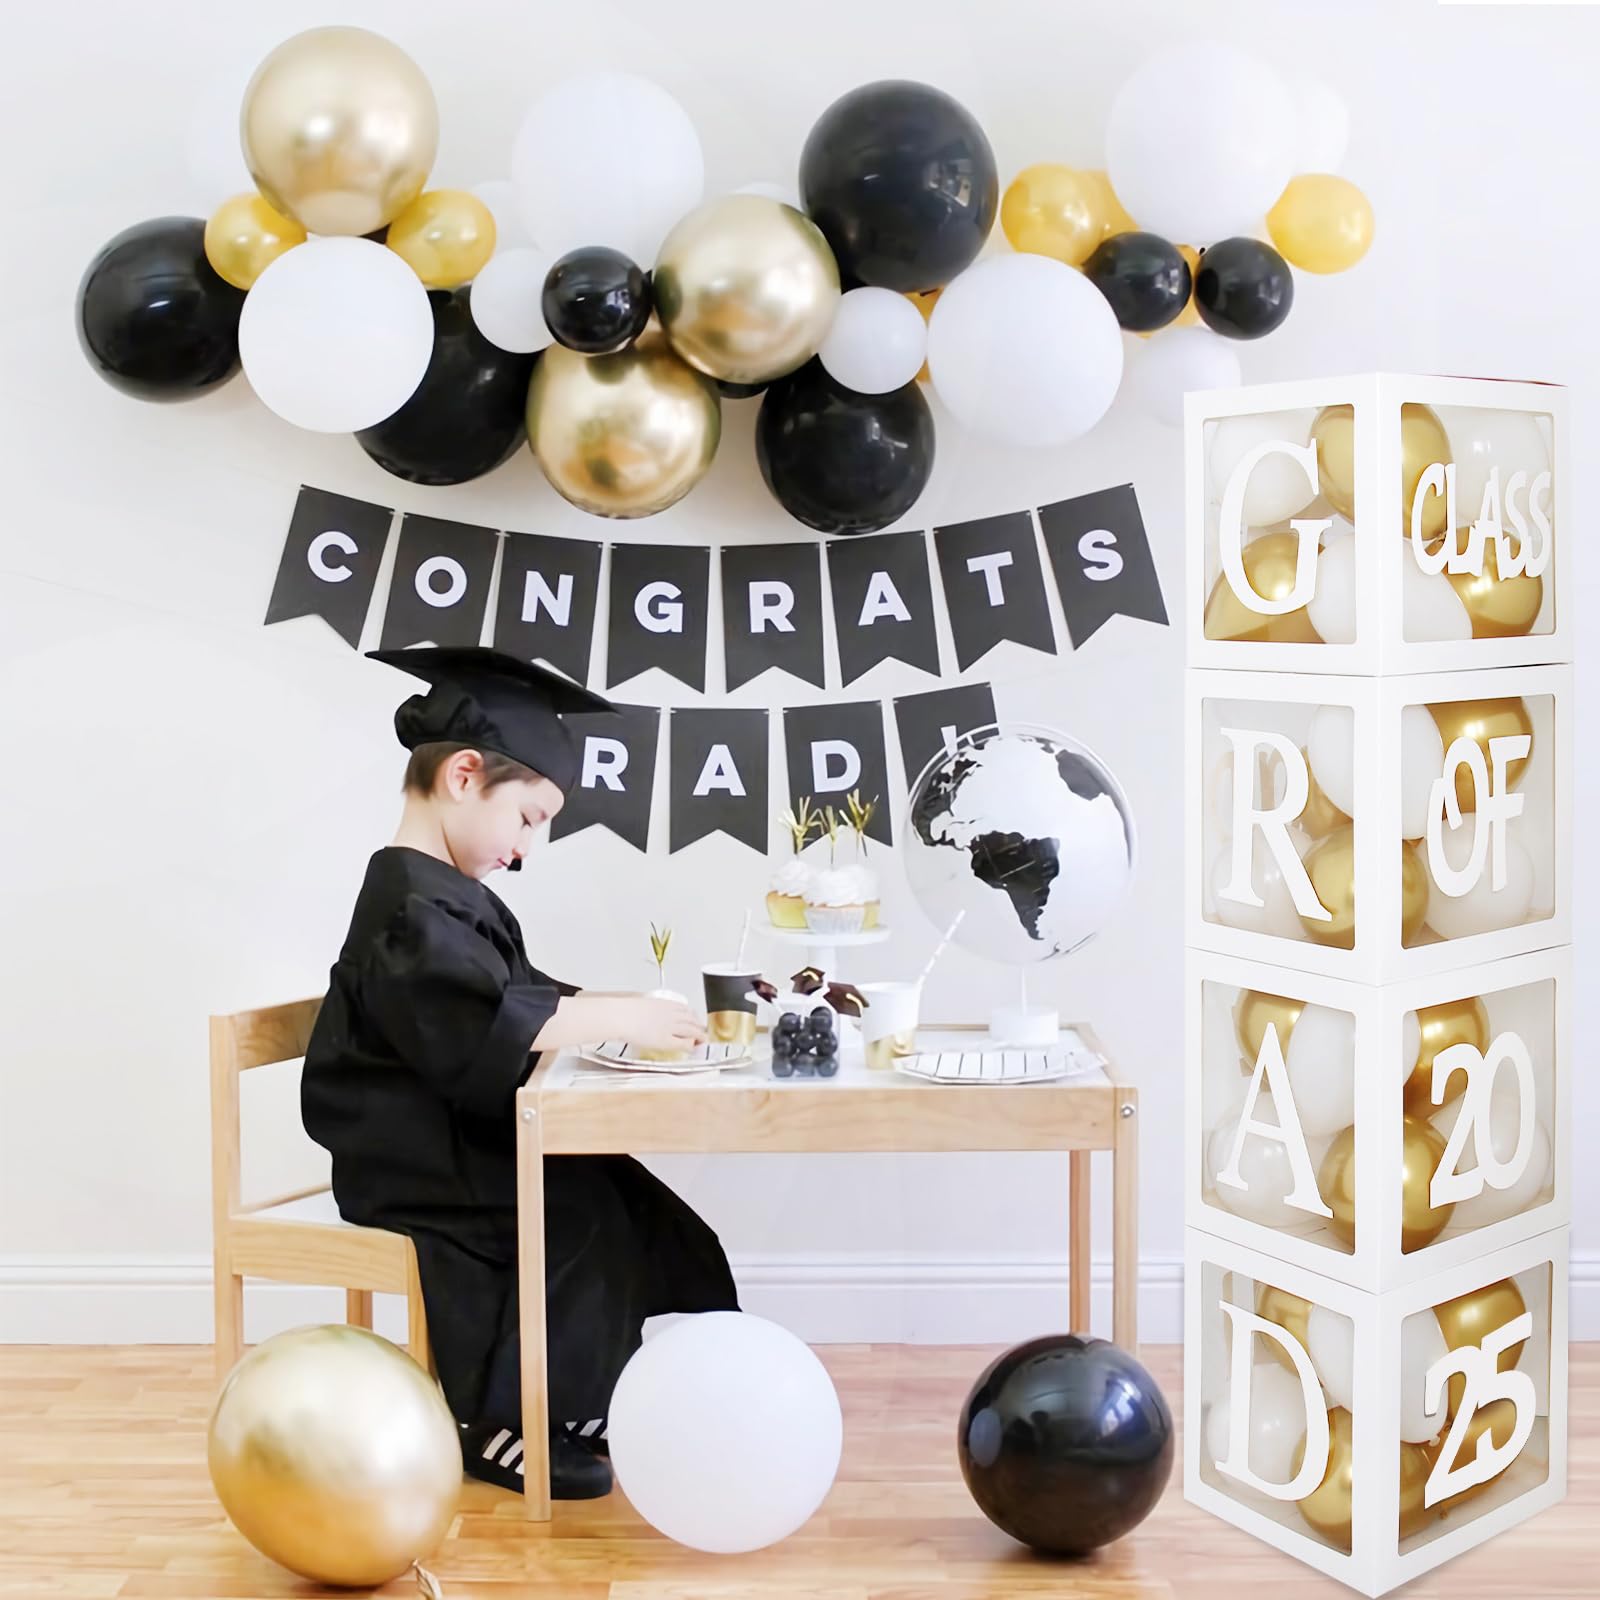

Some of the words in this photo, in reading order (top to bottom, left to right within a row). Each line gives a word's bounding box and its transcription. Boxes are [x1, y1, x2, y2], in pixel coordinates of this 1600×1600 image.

[306, 529, 1125, 635] CONGRATS
[1411, 461, 1552, 581] CLASS
[580, 725, 960, 797] RAD!
[1427, 733, 1532, 899] OF
[1430, 1031, 1537, 1210] 20
[1424, 1311, 1538, 1511] 25
